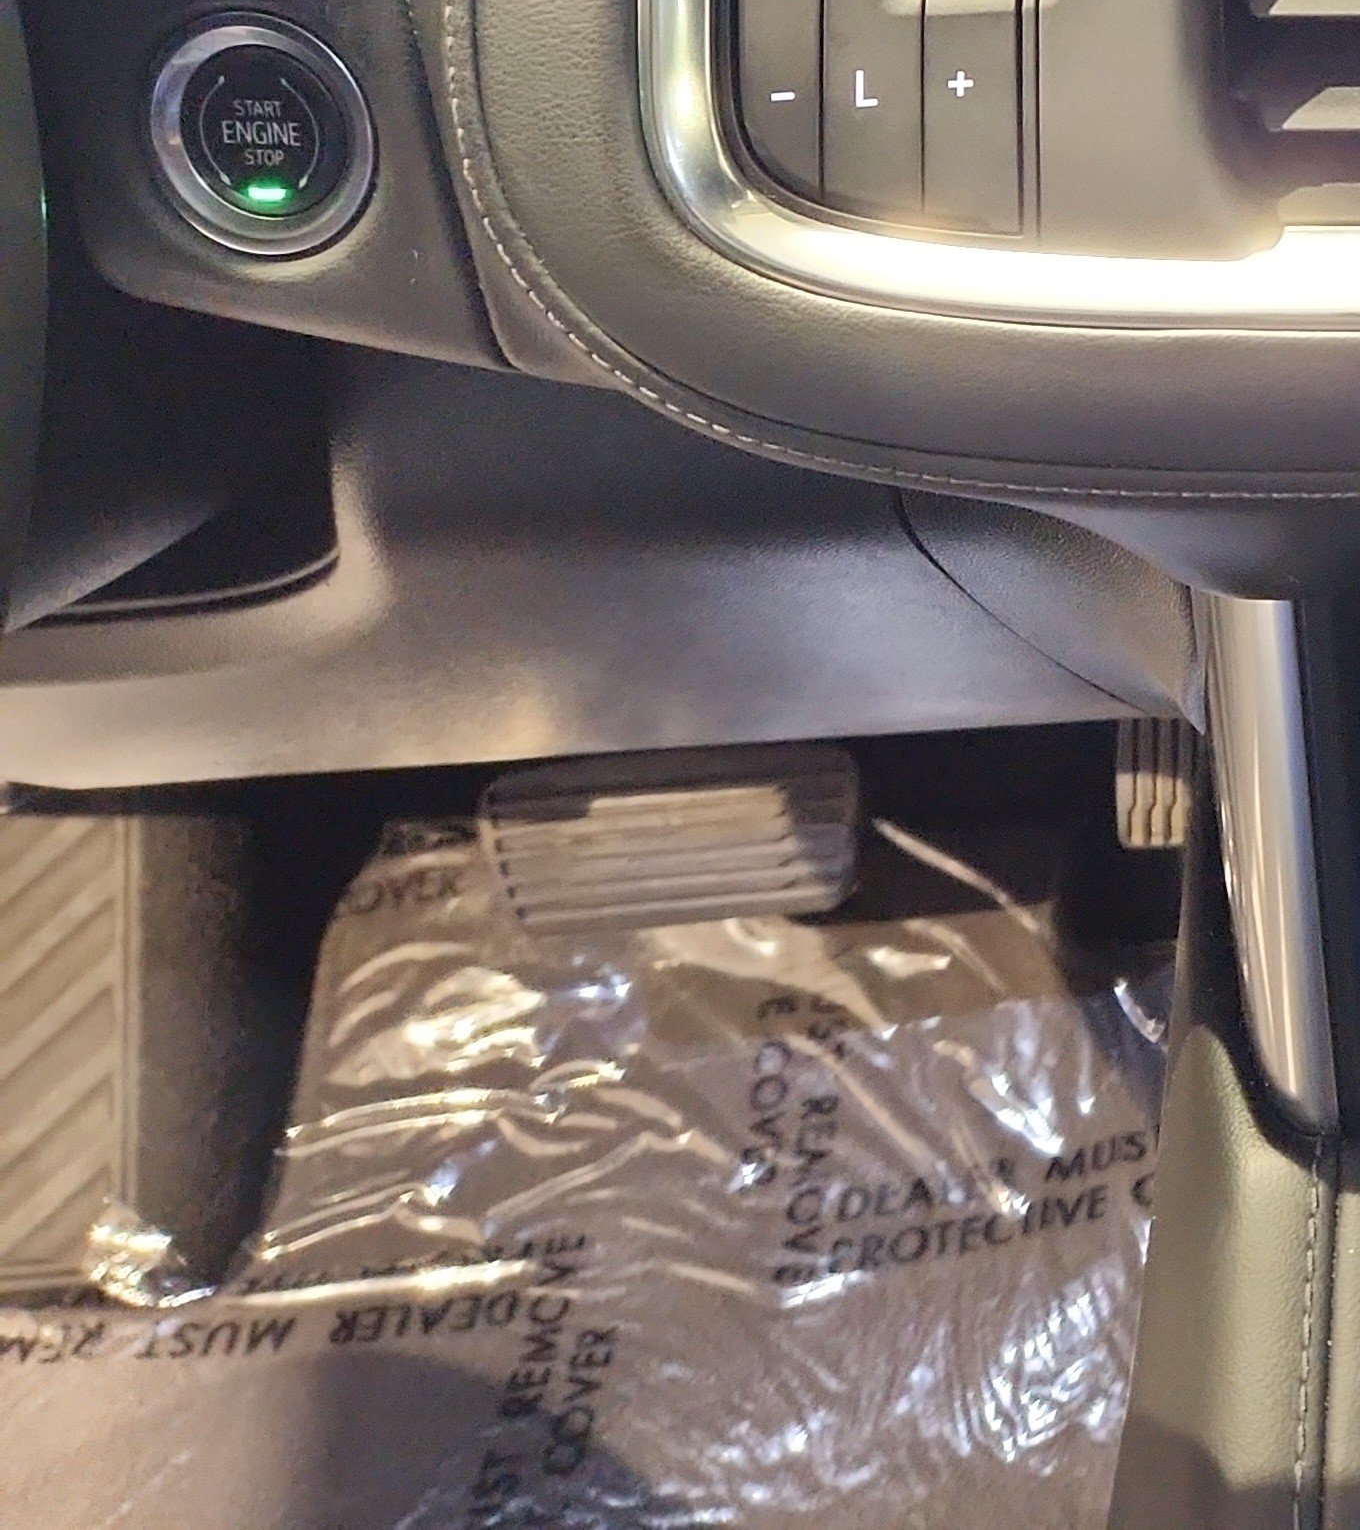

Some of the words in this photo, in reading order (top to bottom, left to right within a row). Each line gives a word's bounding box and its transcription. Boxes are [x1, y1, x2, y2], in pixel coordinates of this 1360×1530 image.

[855, 70, 879, 108] L
[232, 99, 282, 118] START
[222, 120, 301, 147] ENGINE
[244, 149, 285, 167] STOP
